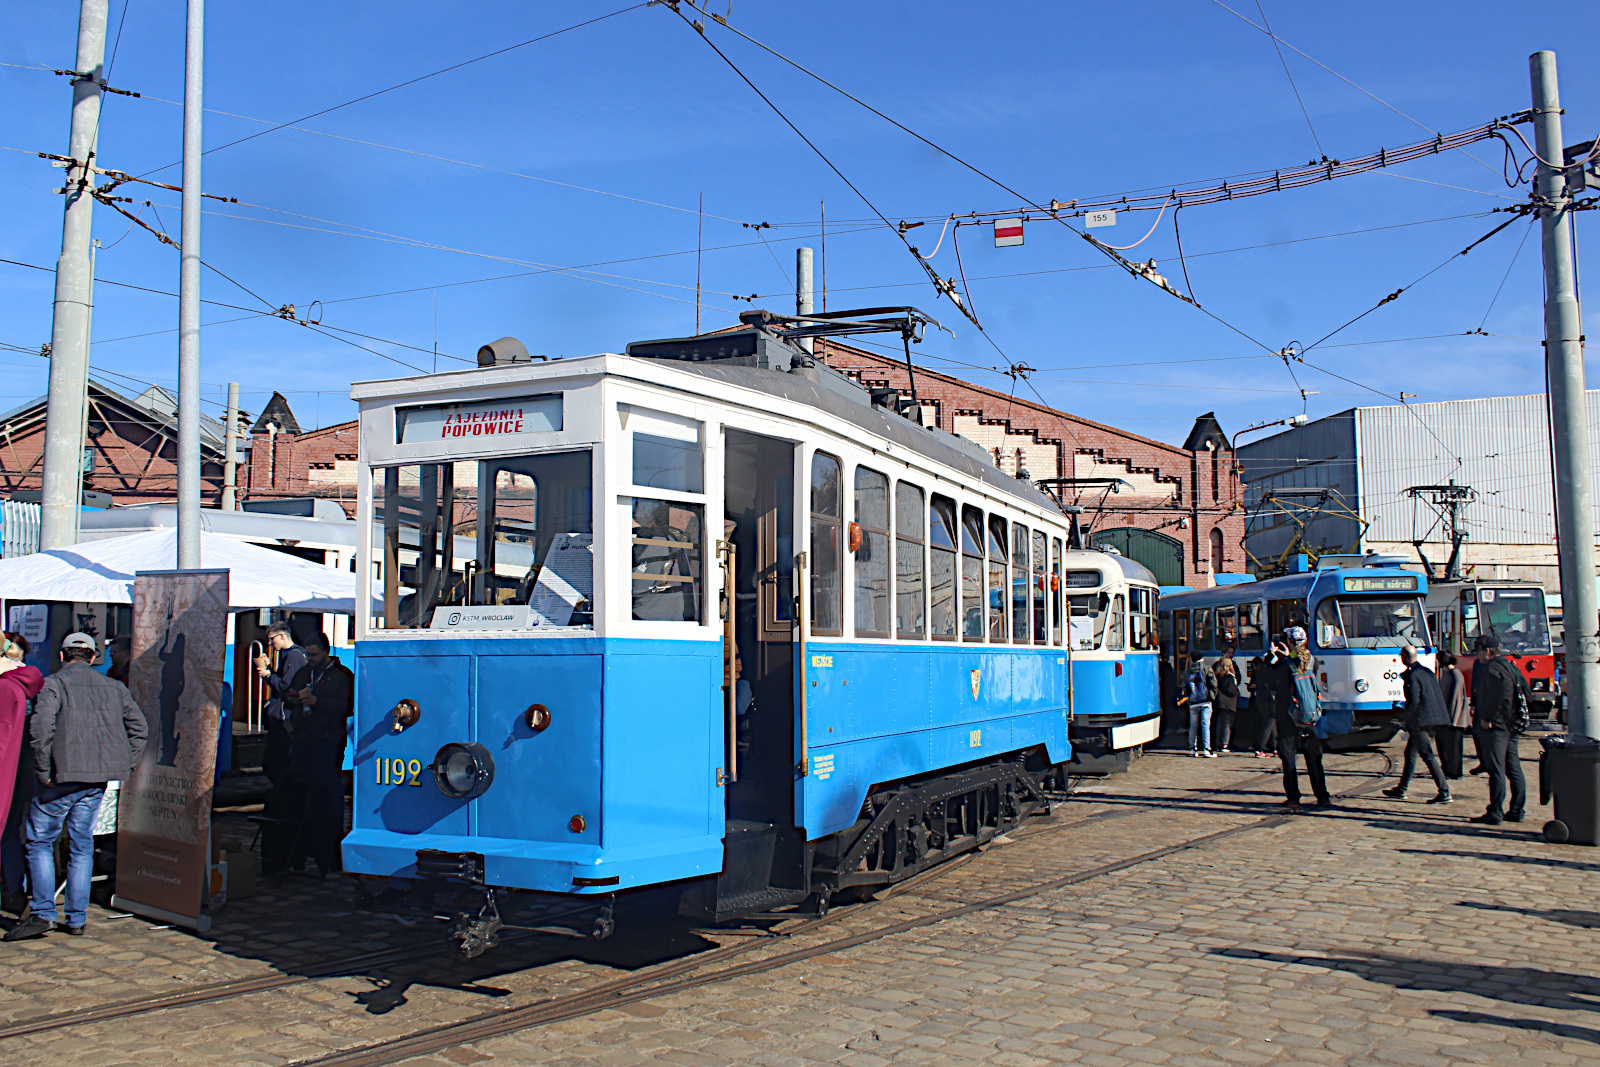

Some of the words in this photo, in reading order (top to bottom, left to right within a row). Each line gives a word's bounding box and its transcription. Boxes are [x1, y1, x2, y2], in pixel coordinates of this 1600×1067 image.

[1093, 213, 1108, 222] 155
[446, 408, 523, 425] ZAJEZDNIA
[441, 420, 524, 438] POPOWICE
[1363, 579, 1385, 589] Hlavní
[1386, 579, 1412, 589] nádraží
[1387, 689, 1401, 697] 999
[970, 729, 982, 749] 1192
[376, 757, 422, 787] 1192
